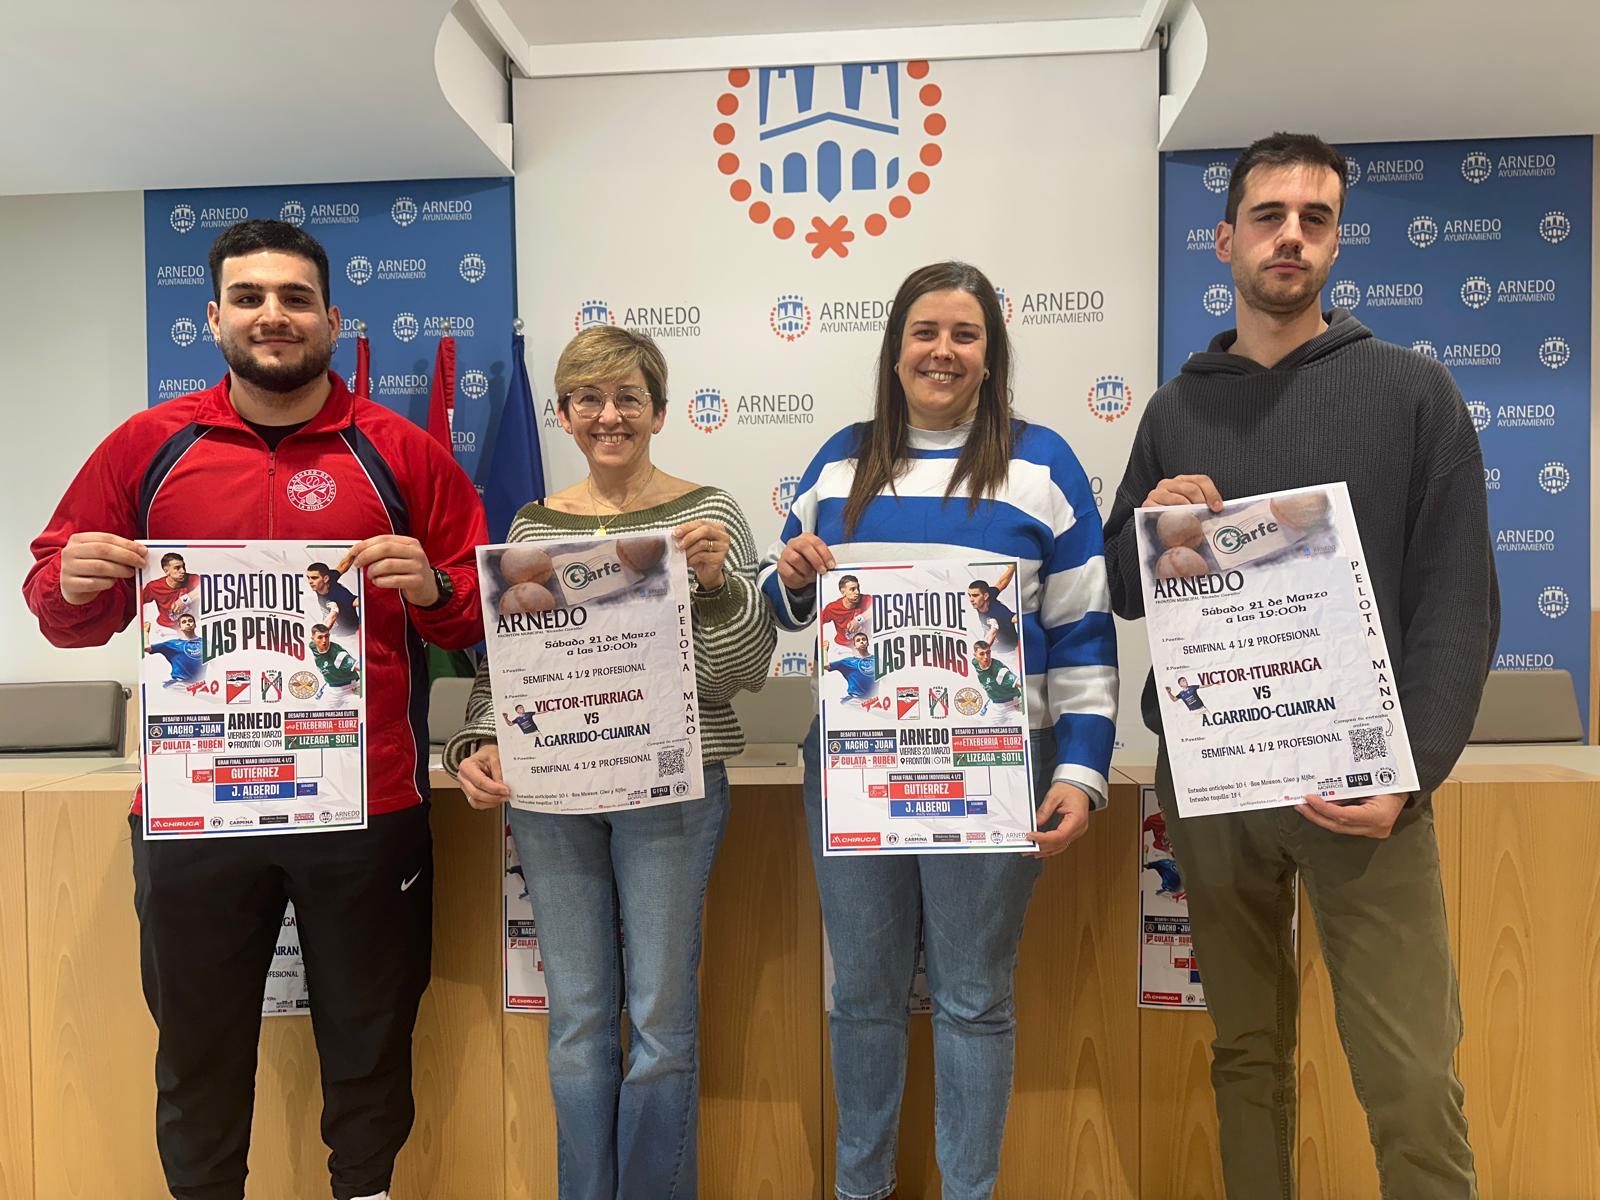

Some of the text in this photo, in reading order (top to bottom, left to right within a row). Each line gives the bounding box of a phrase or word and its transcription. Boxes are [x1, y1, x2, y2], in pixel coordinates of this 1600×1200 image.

[1366, 160, 1424, 173] ARNEDO
[1498, 154, 1556, 168] ARNEDO
[1367, 172, 1424, 182] AYUNTAMIENTO
[1498, 168, 1556, 177] AYUNTAMIENTO
[310, 204, 360, 216] ARNEDO
[422, 200, 472, 213] ARNEDO
[200, 207, 248, 220] ARNEDO
[311, 215, 360, 224] AYUNTAMIENTO
[423, 212, 472, 221] AYUNTAMIENTO
[1444, 218, 1502, 232] ARNEDO
[1444, 232, 1502, 242] AYUNTAMIENTO
[157, 265, 204, 278] ARNEDO
[378, 259, 426, 272] ARNEDO
[158, 277, 205, 286] AYUNTAMIENTO
[378, 270, 426, 280] AYUNTAMIENTO
[1366, 283, 1423, 297] ARNEDO
[1497, 279, 1556, 293] ARNEDO
[1022, 290, 1104, 311] ARNEDO
[1366, 296, 1423, 306] AYUNTAMIENTO
[1498, 292, 1556, 302] AYUNTAMIENTO
[624, 306, 700, 326] ARNEDO
[1022, 312, 1104, 326] AYUNTAMIENTO
[820, 320, 887, 333] AYUNTAMIEN
[1443, 343, 1501, 358] ARNEDO
[158, 378, 206, 392] ARNEDO
[378, 374, 428, 388] ARNEDO
[379, 386, 428, 395] AYUNTAMIENTO
[736, 394, 814, 412] ARNEDO
[1496, 404, 1555, 418] ARNEDO
[738, 414, 814, 424] AYUNTAMIENTO
[1497, 418, 1555, 428] AYUNTAMIENTO
[1496, 529, 1555, 543] ARNEDO
[1497, 542, 1555, 552] AYUNTAMIENTO
[1154, 570, 1244, 599] ARNEDO
[200, 570, 304, 614] DESAFÍO DE
[1249, 600, 1264, 611] 21
[1268, 598, 1283, 608] de
[872, 589, 966, 634] DESAFÍO DE
[1236, 612, 1254, 622] las
[1258, 604, 1306, 620] 19:00h
[496, 606, 588, 634] ARNEDO
[202, 614, 304, 665] LAS PEÑAS
[589, 635, 602, 644] 21
[605, 634, 618, 642] de
[1182, 628, 1320, 655] SEMIFINAL 4 1/2 PROFESIONAL
[577, 646, 594, 655] las
[596, 642, 638, 652] 19:00h
[874, 632, 968, 680] LAS PEÑAS
[1496, 654, 1554, 667] ARNEDO
[523, 664, 646, 684] SEMIFINAL 4 1/2 PROFESIONAL
[1198, 656, 1322, 686] VICTOR-ITURRIAGA
[1252, 684, 1272, 700] VS
[534, 688, 644, 713] VICTOR-ITURRIAGA
[1201, 696, 1336, 727] A.GARRIDO-CUAIRAN
[228, 712, 282, 730] ARNEDO
[295, 720, 357, 730] ETXEBERRIA ELORZ
[584, 712, 600, 725] VS
[168, 724, 220, 734] NACHO JUAN
[228, 730, 282, 740] VIERNES 20 MARZO
[534, 723, 650, 748] A.GARRIDO-CUAIRAN
[300, 735, 356, 745] LIZEAGA SOTIL
[900, 728, 949, 746] ARNEDO
[962, 737, 1021, 747] ETXEBERRIA ELORZ
[163, 740, 191, 750] CULATA
[272, 740, 282, 748] 17H
[845, 740, 893, 750] NACHO JUAN
[1201, 732, 1342, 759] SEMIFINAL 4 1/2 PROFESIONAL
[900, 746, 950, 756] VIERNES 20 MARZO
[966, 752, 1022, 762] LIZEAGA SOTIL
[530, 754, 652, 774] SEMIFINAL 4 1/2 PROFESIONAL
[841, 756, 867, 765] CULATA
[941, 756, 950, 764] 17H
[232, 784, 279, 797] J. ALBERDI
[905, 801, 950, 813] J. ALBERDI
[1154, 935, 1174, 943] CULATA
